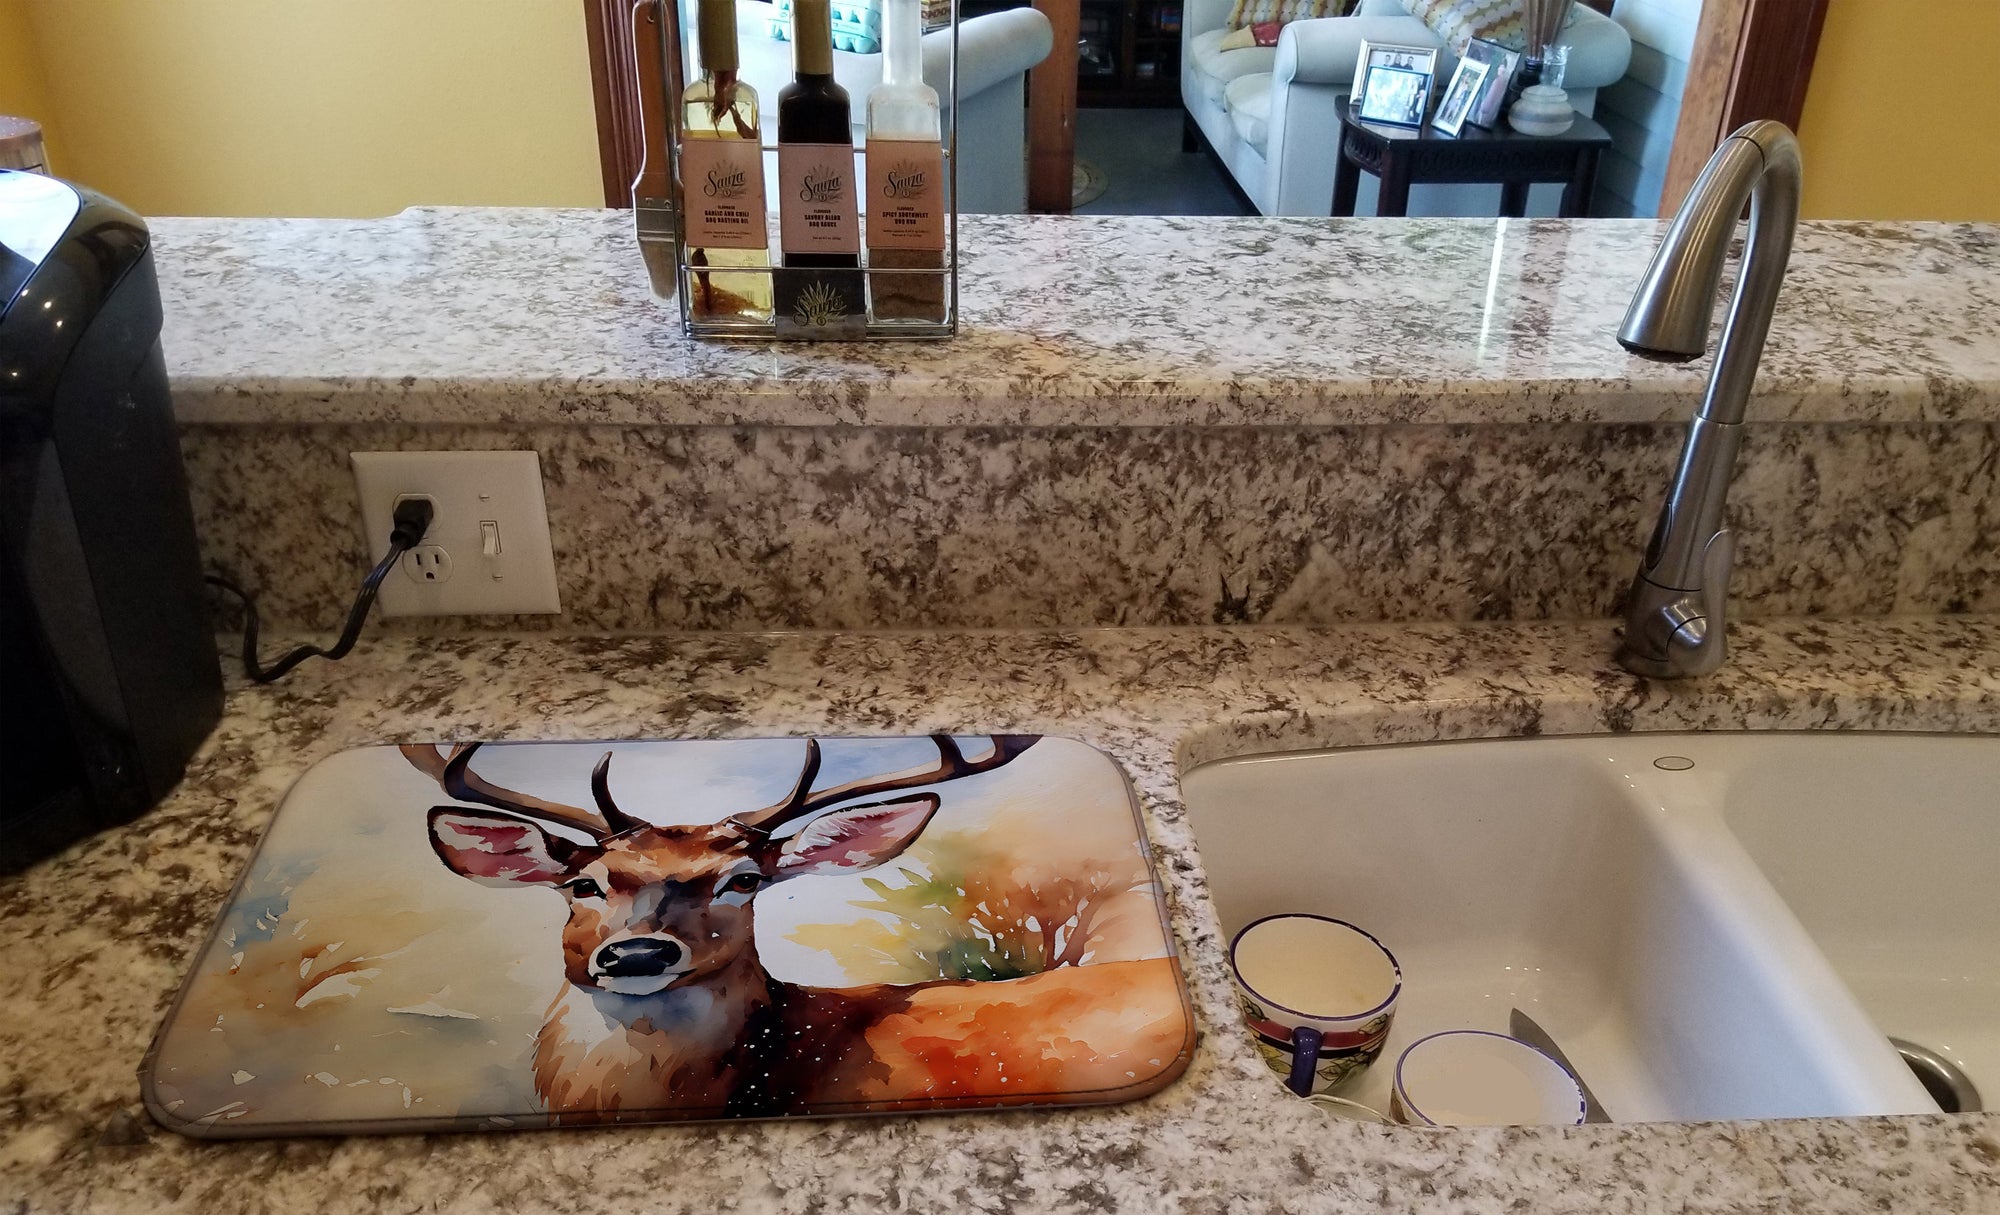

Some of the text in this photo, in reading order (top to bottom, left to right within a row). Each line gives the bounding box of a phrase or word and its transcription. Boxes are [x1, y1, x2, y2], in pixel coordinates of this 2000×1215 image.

[703, 170, 746, 197] Sauza
[800, 175, 842, 202] Sauza
[883, 170, 926, 198] Sauza
